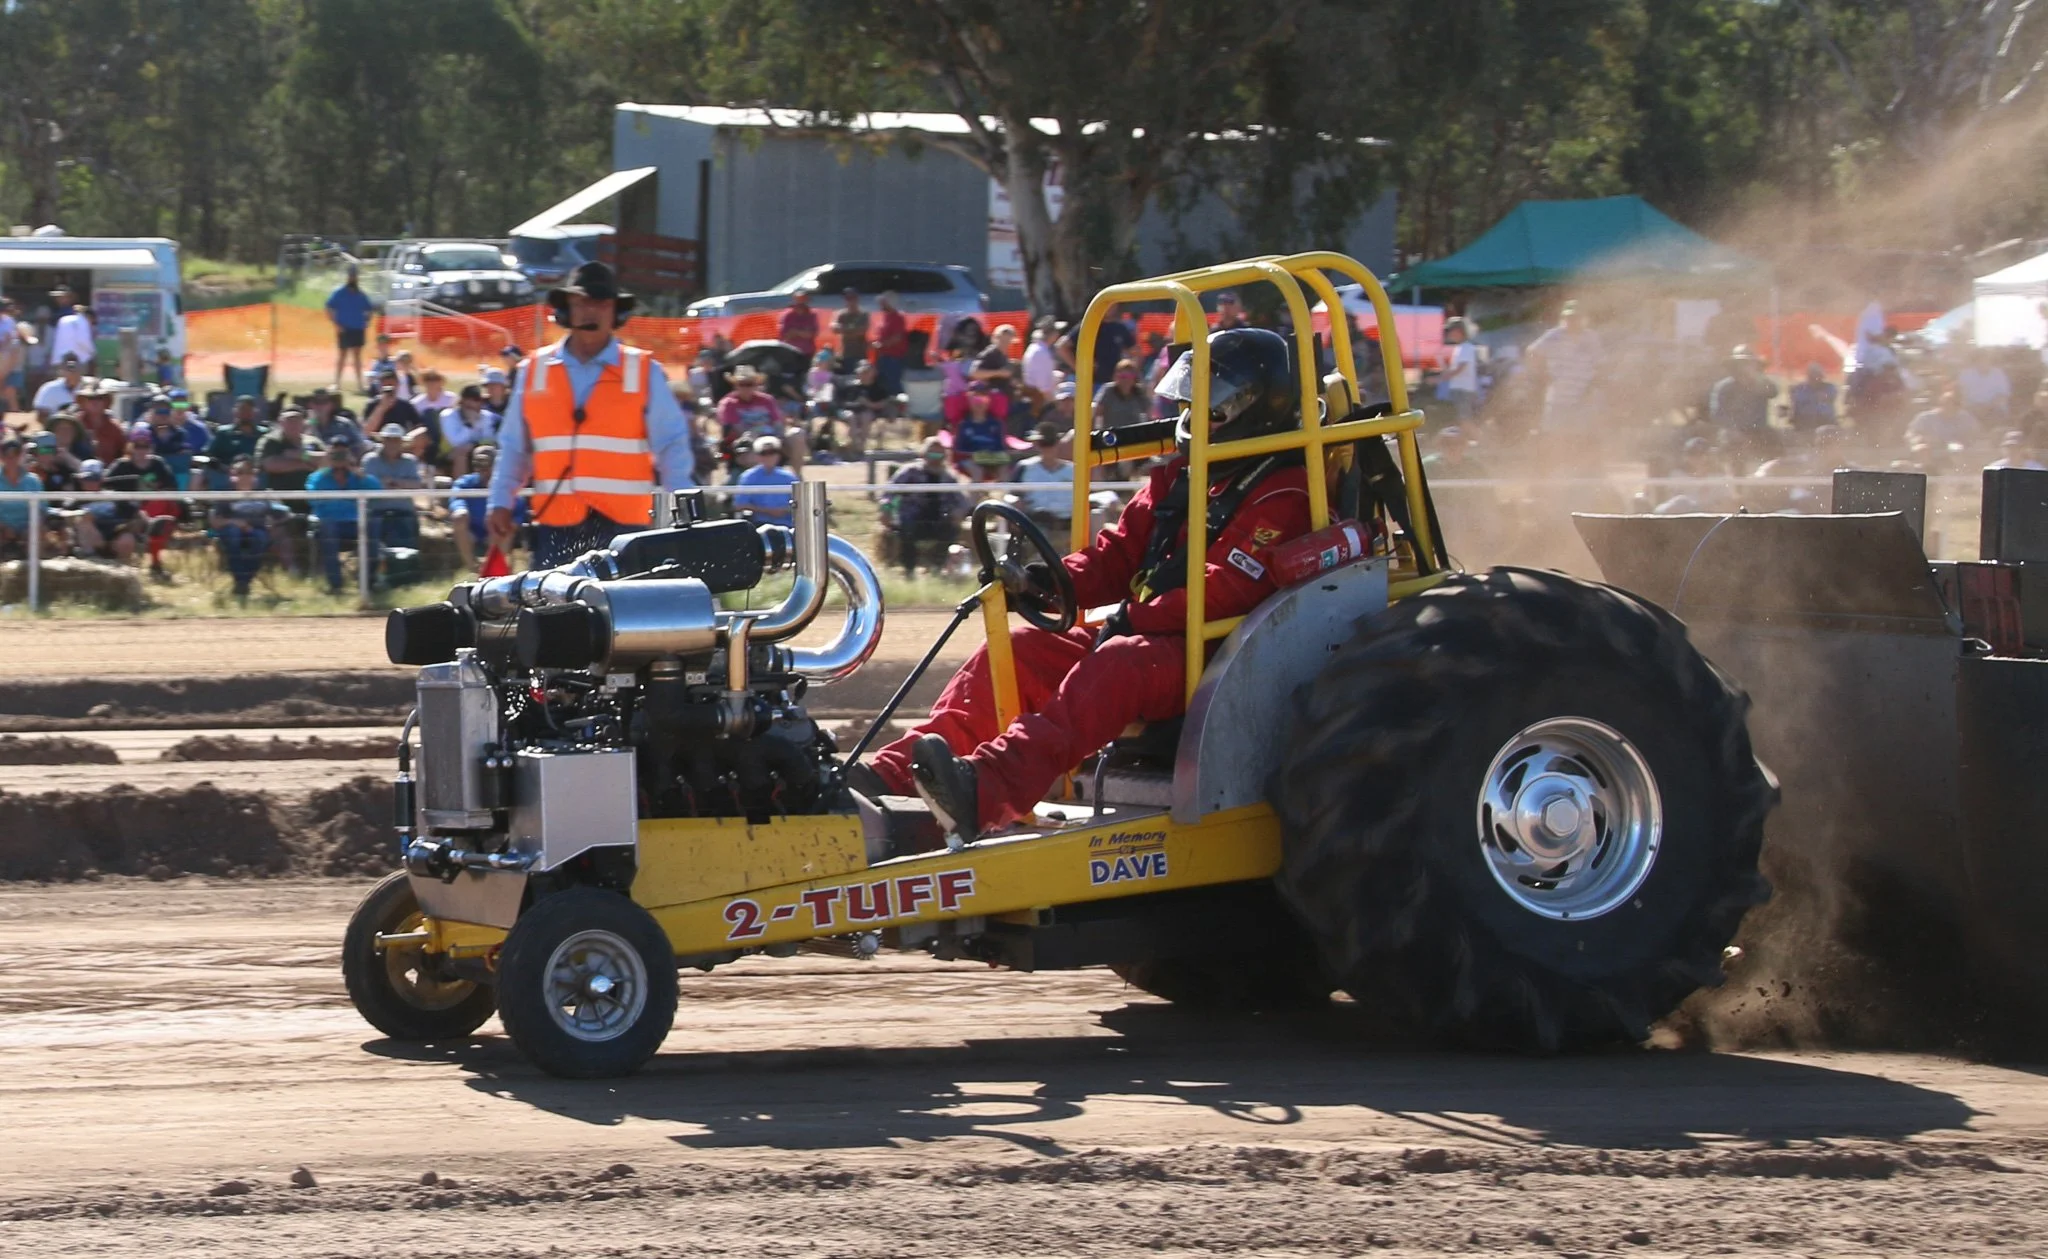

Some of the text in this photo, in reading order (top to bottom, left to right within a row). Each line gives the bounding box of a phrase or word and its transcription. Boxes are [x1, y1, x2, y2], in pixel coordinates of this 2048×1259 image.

[1088, 832, 1166, 848] In Memory
[1088, 851, 1168, 886] DAVE
[724, 868, 975, 941] 2-TUFF
